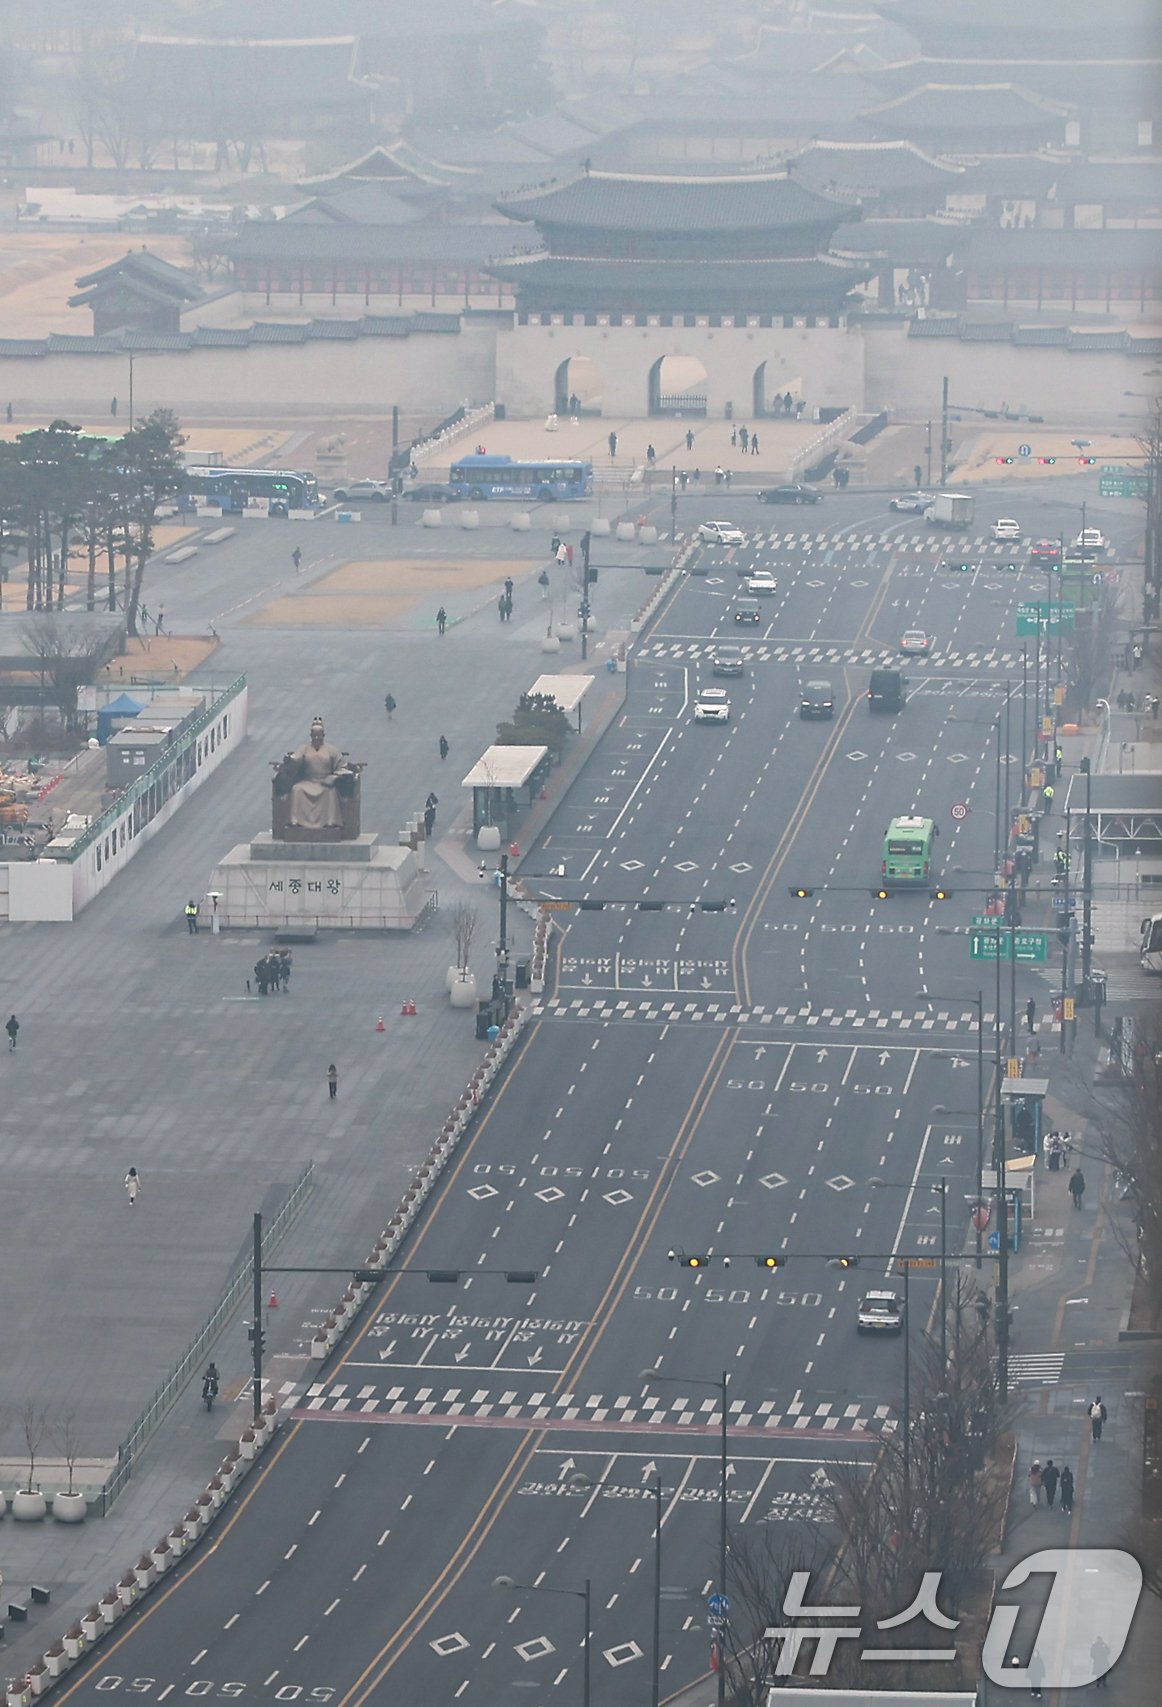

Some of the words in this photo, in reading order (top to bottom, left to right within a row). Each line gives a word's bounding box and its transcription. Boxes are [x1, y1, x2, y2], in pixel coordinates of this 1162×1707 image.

[954, 808, 964, 816] 50
[269, 879, 341, 895] 세종대왕
[821, 924, 856, 933] 50
[879, 924, 913, 933] 50
[726, 1079, 765, 1090] 50
[789, 1082, 829, 1093] 50
[853, 1084, 893, 1095] 50
[473, 1163, 516, 1175] 50
[540, 1166, 583, 1178] 50
[607, 1168, 650, 1180] 50
[633, 1286, 678, 1300] 50
[704, 1289, 750, 1303] 50
[776, 1292, 822, 1306] 50
[95, 1675, 156, 1693] 50
[185, 1680, 247, 1698] 50
[274, 1685, 336, 1702] 50
